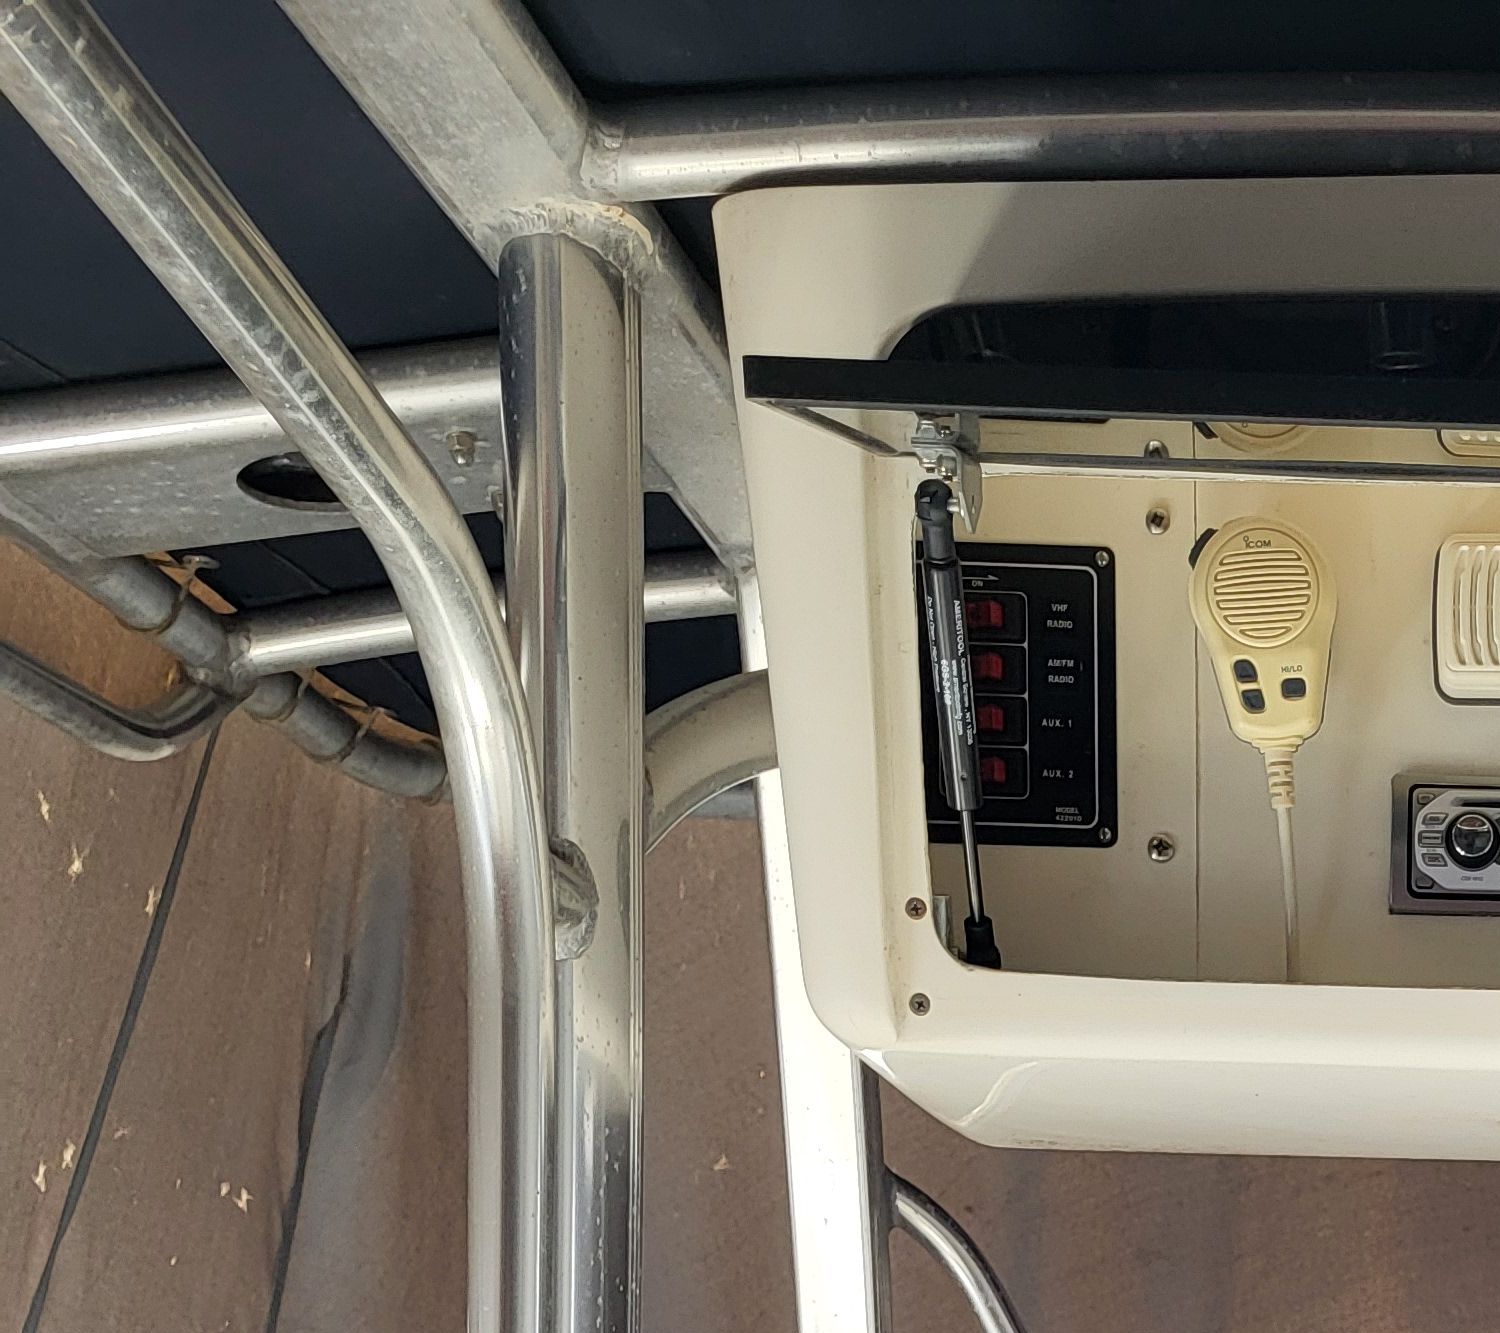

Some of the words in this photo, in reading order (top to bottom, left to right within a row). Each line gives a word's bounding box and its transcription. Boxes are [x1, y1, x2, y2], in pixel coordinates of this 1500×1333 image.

[1051, 604, 1068, 612] VHF
[1047, 620, 1073, 629] RADIO
[1048, 675, 1075, 684] RADIO
[1041, 718, 1064, 727] AUX.
[1042, 768, 1065, 778] AUX.
[1068, 769, 1075, 779] 2
